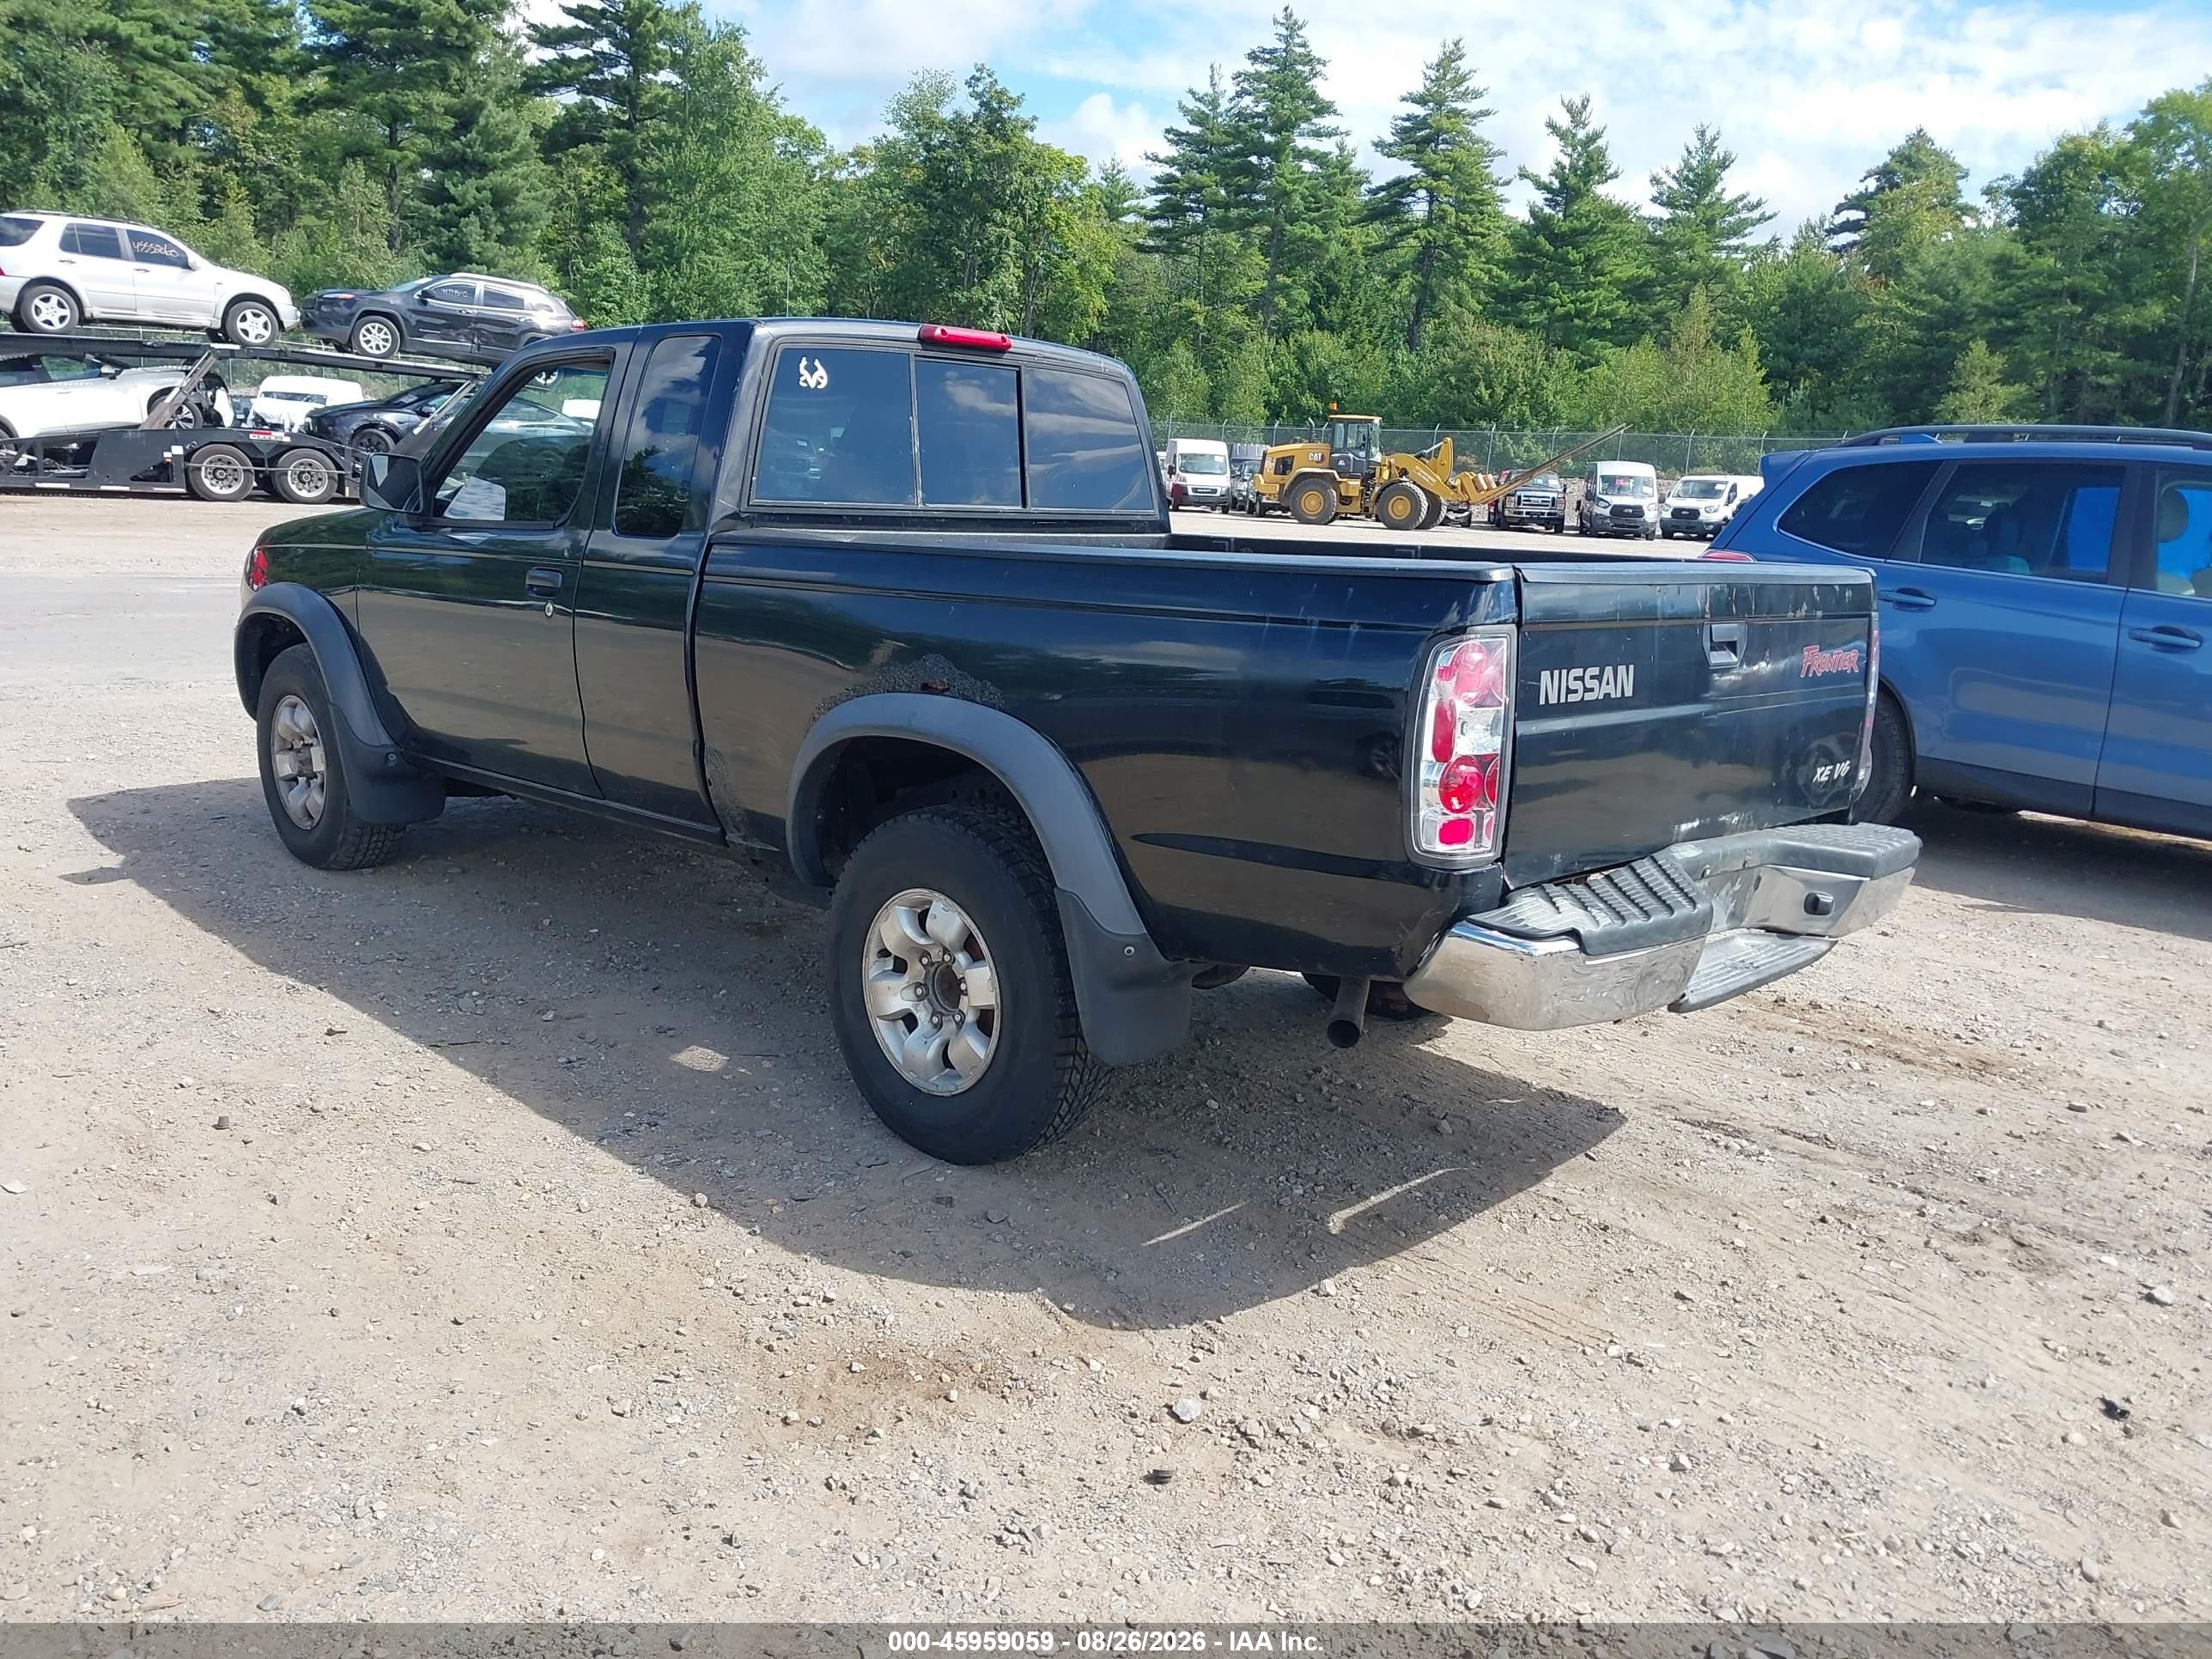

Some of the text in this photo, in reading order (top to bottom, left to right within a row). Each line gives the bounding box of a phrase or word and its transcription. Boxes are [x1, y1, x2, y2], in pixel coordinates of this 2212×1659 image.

[1309, 453, 1322, 462] CAT
[1800, 645, 1859, 678] FRONTIER
[1539, 664, 1635, 706] NISSAN
[1813, 759, 1851, 782] XE V6
